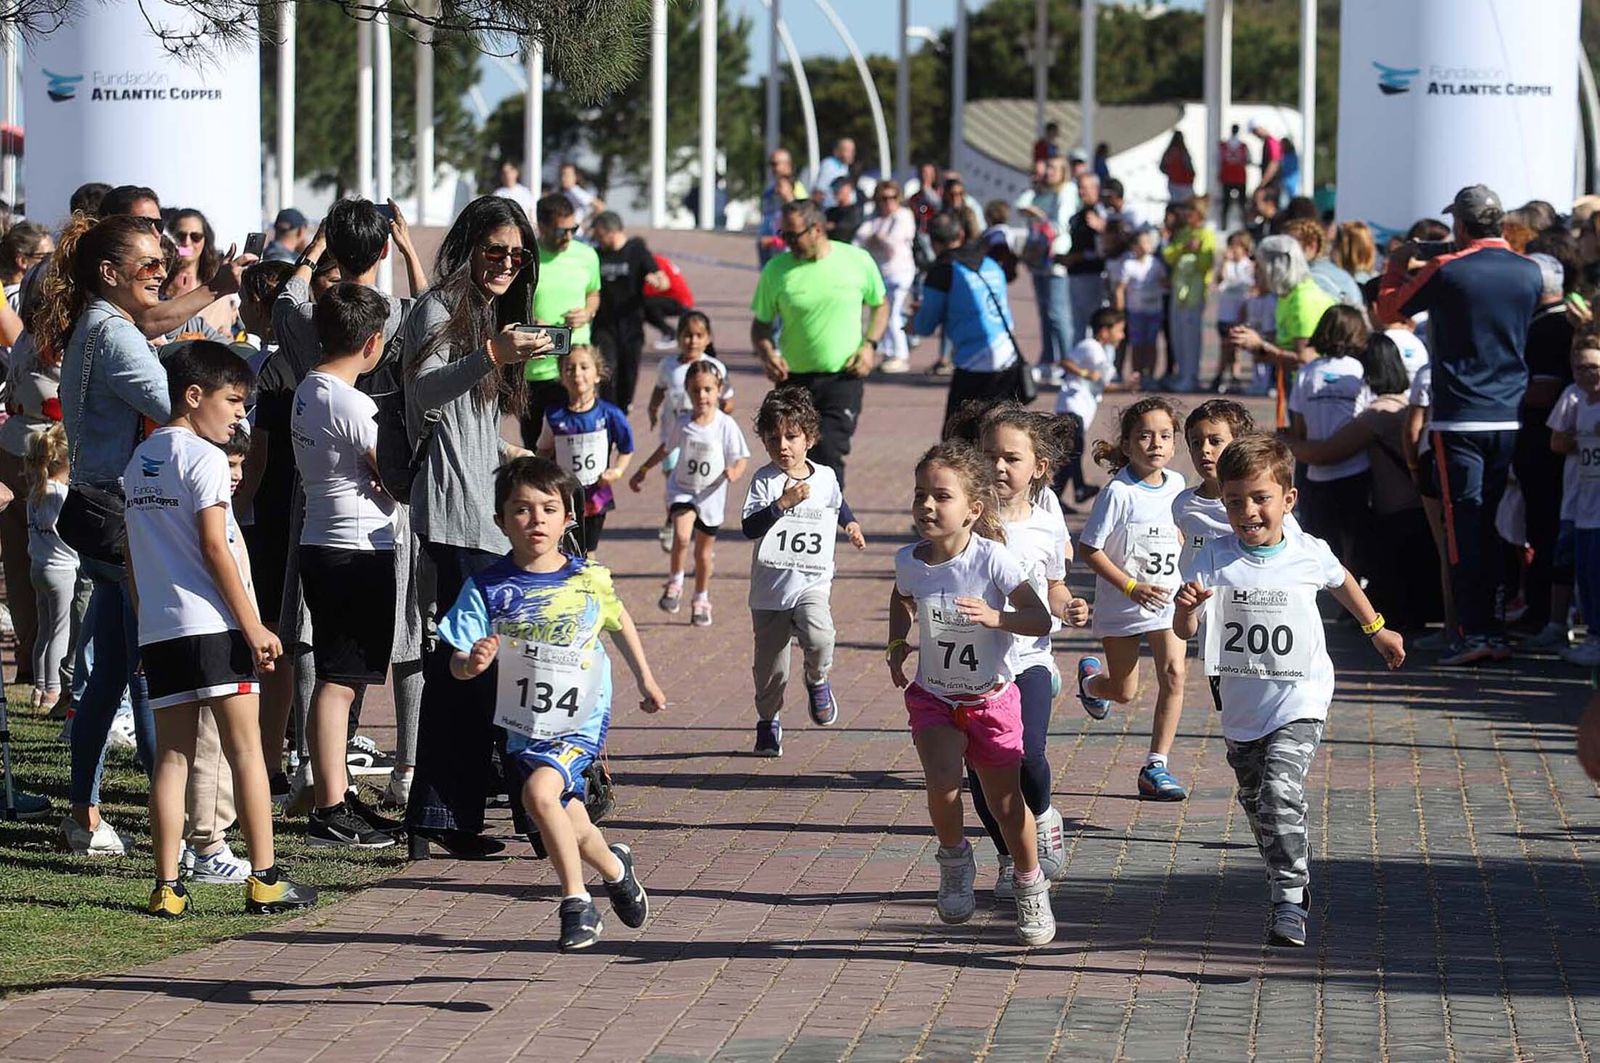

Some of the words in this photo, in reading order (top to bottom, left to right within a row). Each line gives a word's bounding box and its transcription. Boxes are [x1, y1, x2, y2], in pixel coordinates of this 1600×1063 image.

[92, 70, 169, 86] Fundación
[91, 87, 167, 101] ATLANTIC
[169, 87, 222, 100] COPPER
[1427, 82, 1500, 96] ATLANTIC
[572, 454, 596, 473] 56
[688, 459, 711, 477] 90
[776, 530, 823, 555] 163
[1146, 552, 1176, 576] 35
[1233, 590, 1247, 601] H
[932, 609, 942, 620] H
[1224, 621, 1294, 656] 200
[525, 644, 539, 656] H
[937, 640, 979, 672] 74
[1213, 665, 1239, 674] Huelva
[1259, 668, 1271, 676] tus
[515, 677, 580, 718] 134
